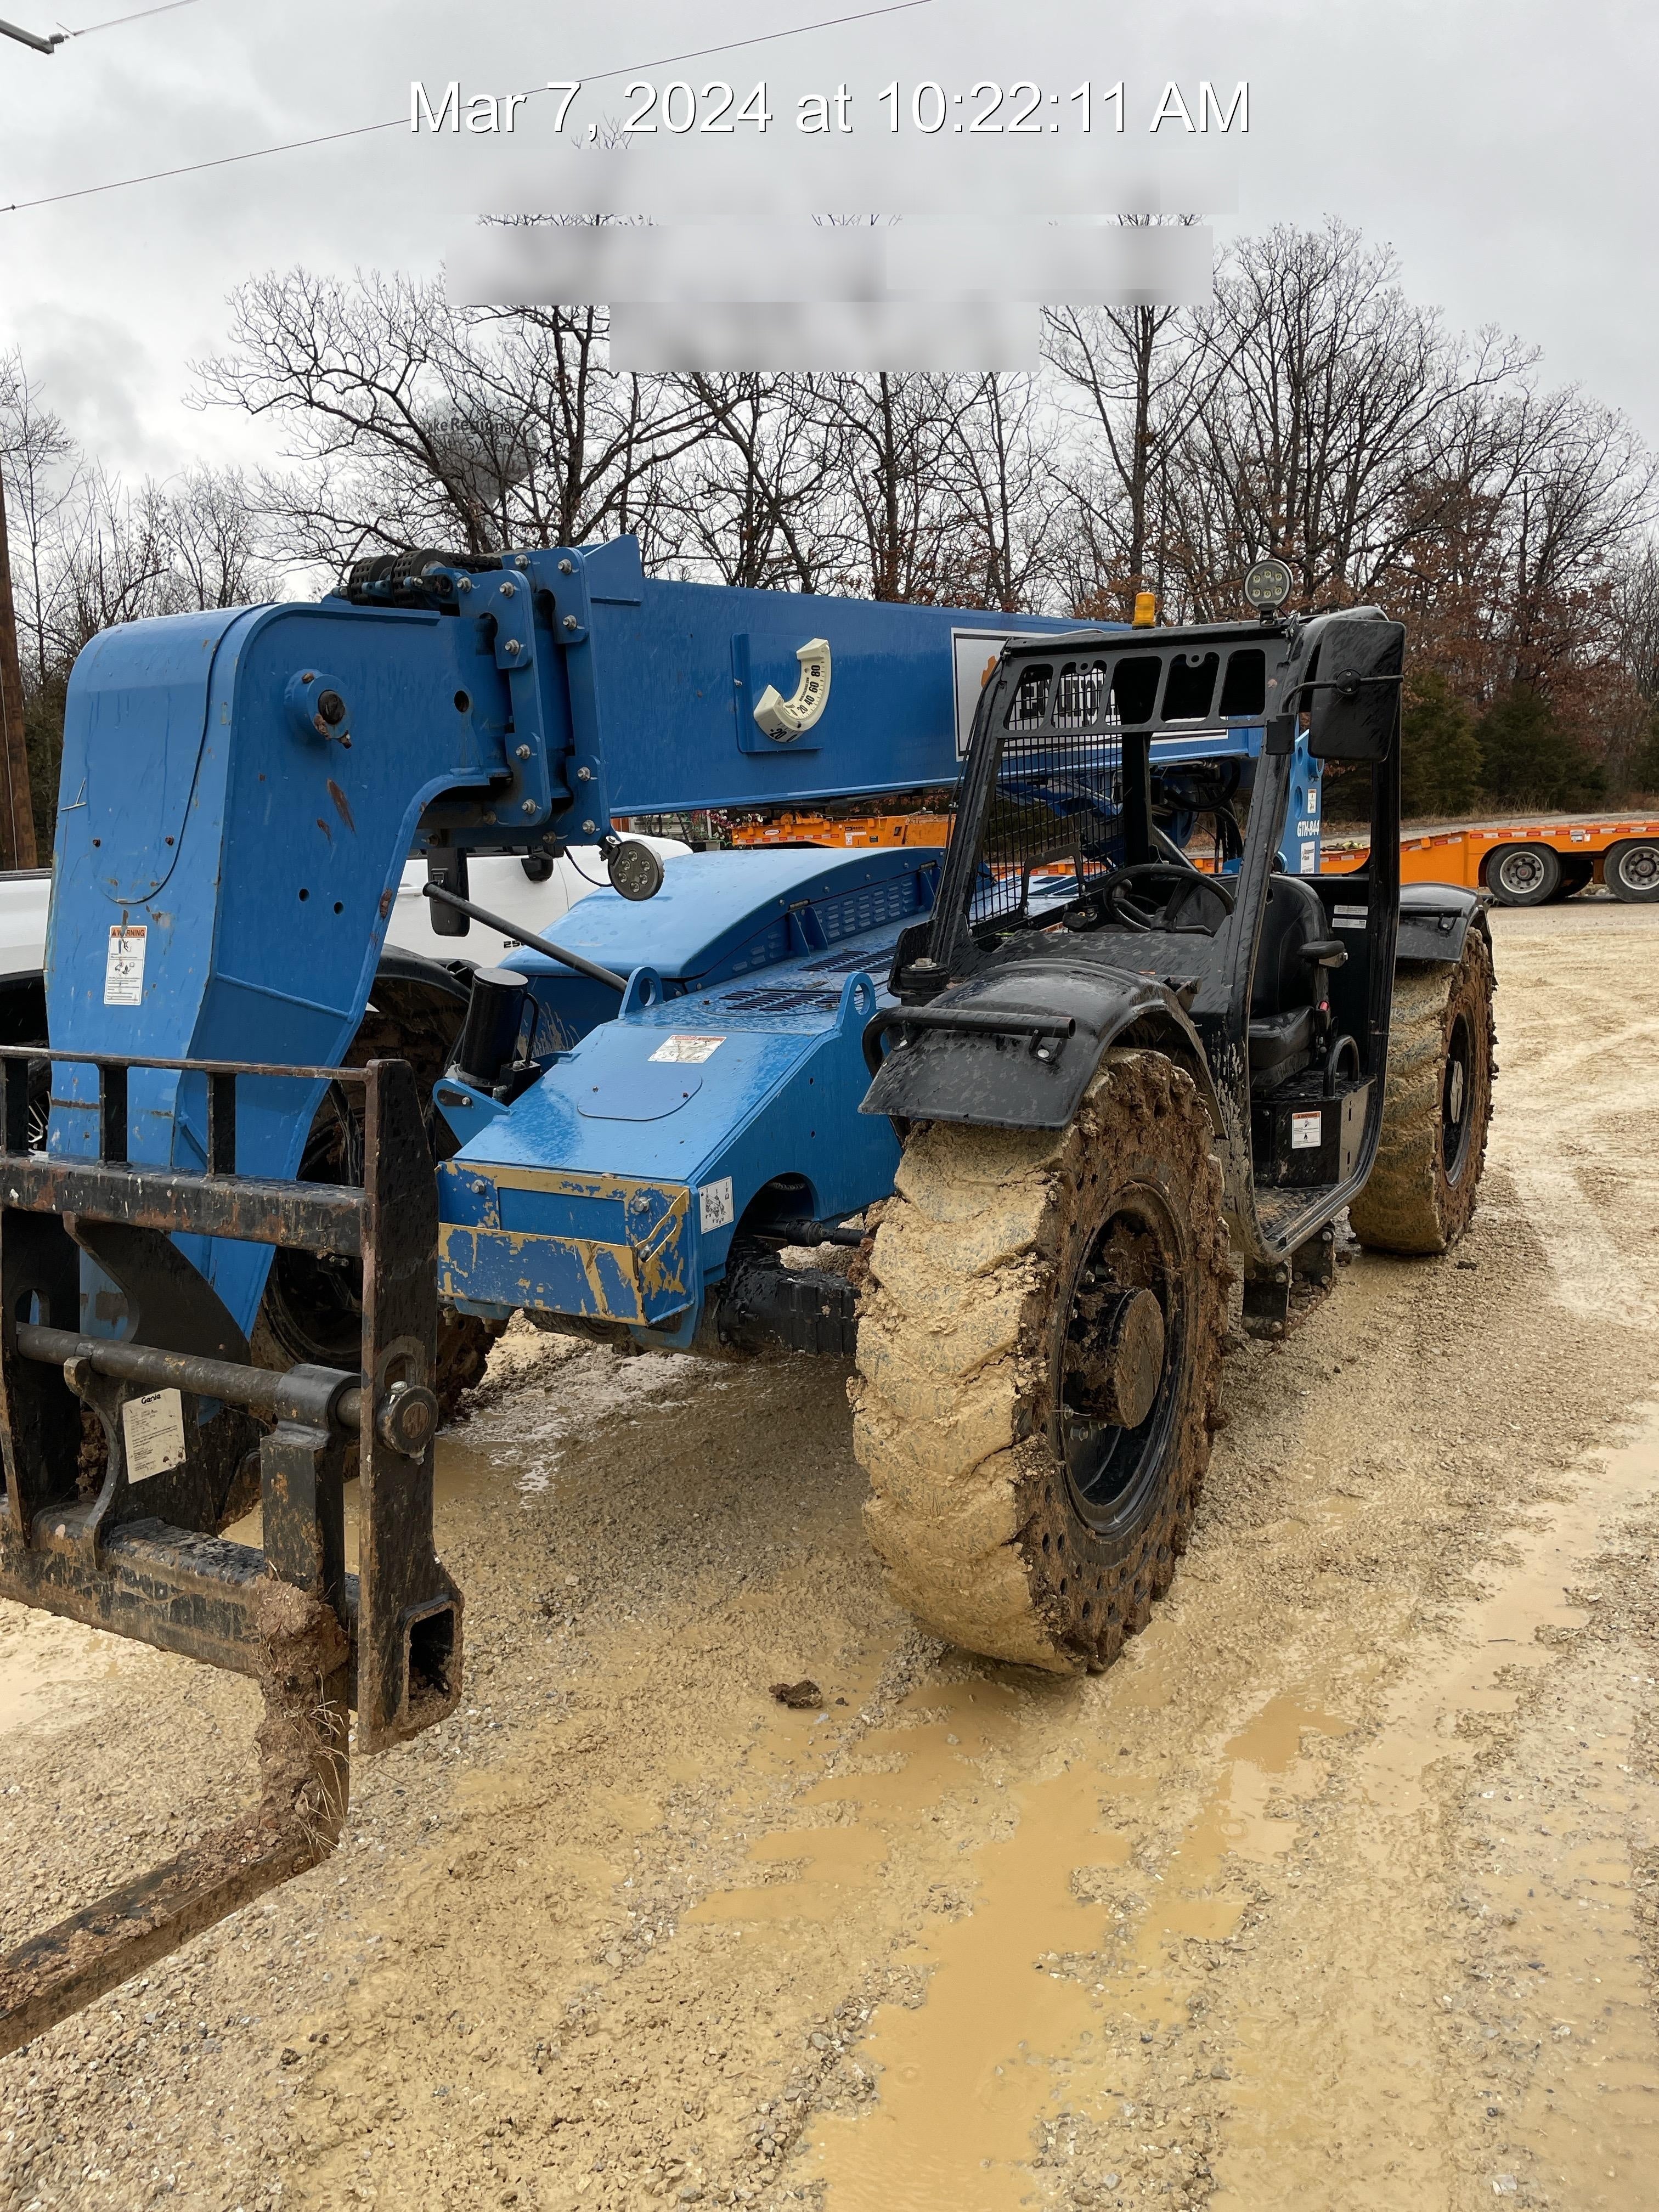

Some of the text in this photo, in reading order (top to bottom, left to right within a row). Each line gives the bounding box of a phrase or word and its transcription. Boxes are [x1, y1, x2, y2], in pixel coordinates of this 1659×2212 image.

[811, 665, 821, 677] 80
[809, 681, 819, 693] 60
[804, 695, 815, 706] 40
[797, 704, 808, 714] 20
[1297, 820, 1320, 837] GTH-844
[141, 1393, 161, 1404] Genie
